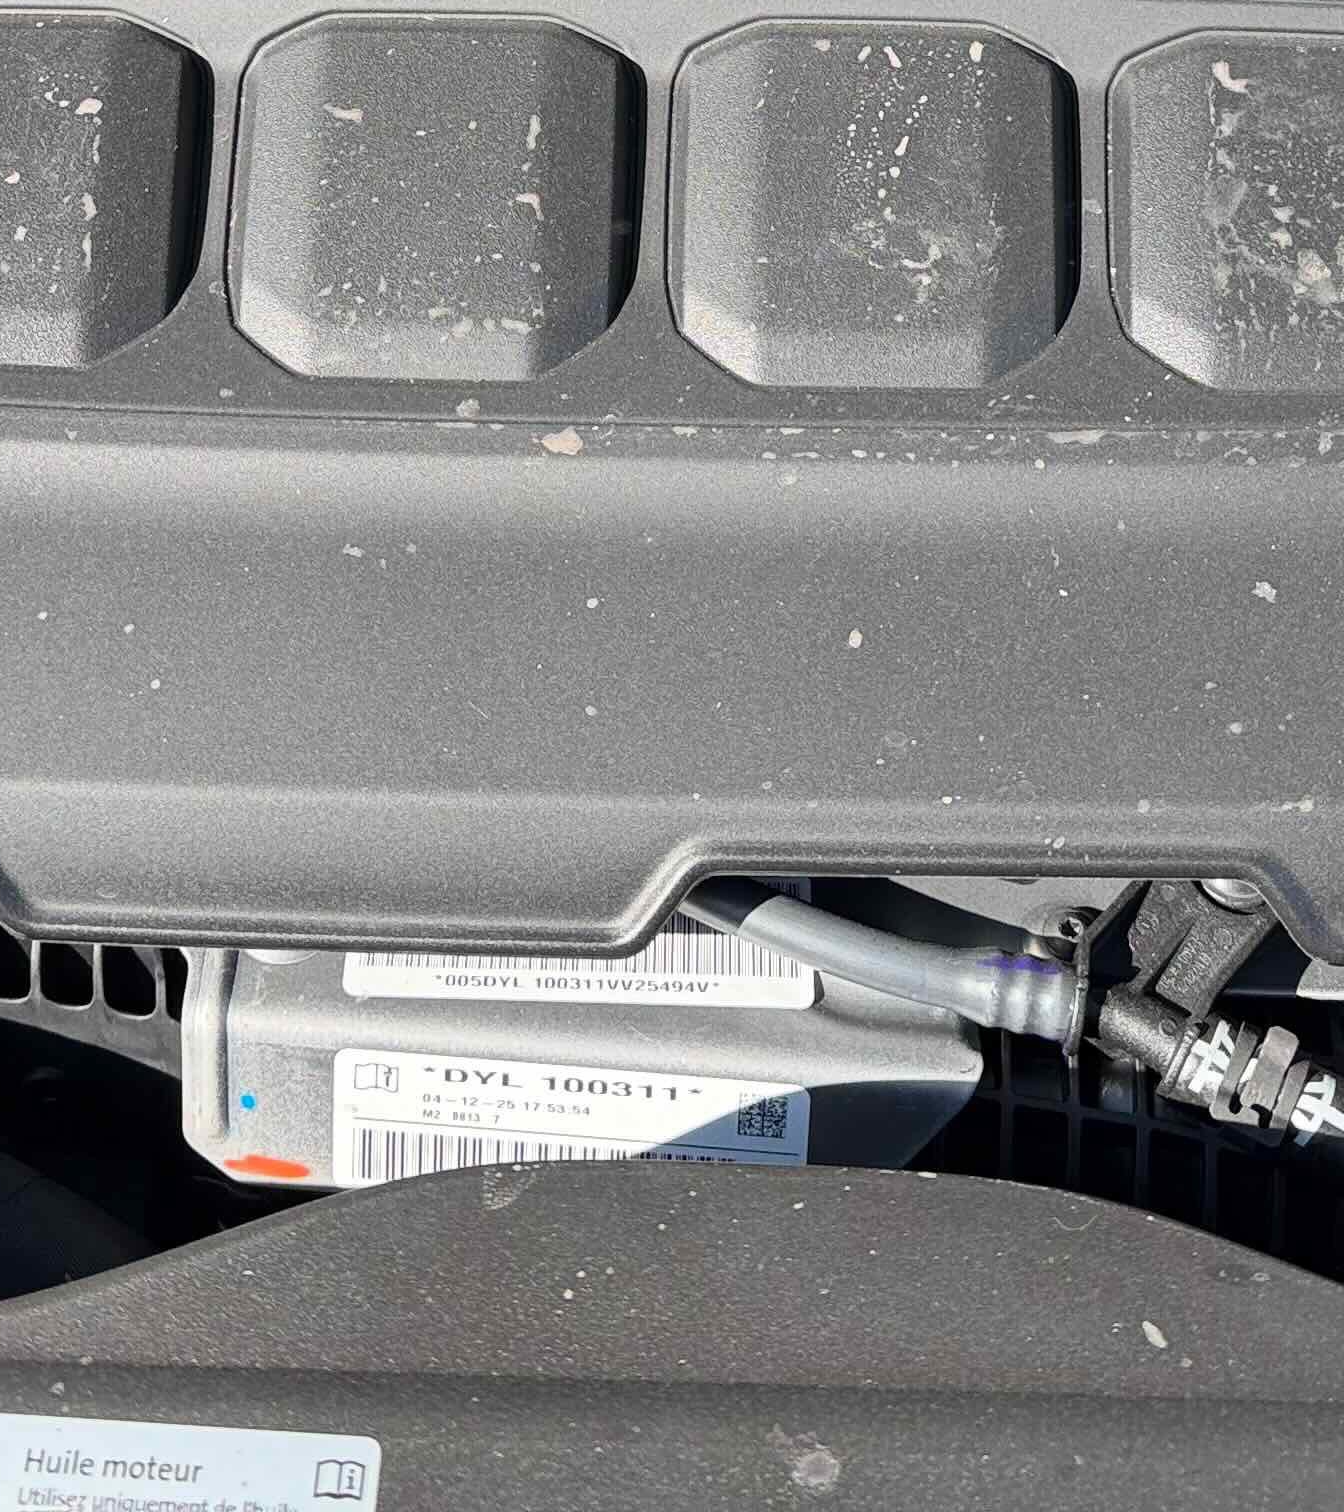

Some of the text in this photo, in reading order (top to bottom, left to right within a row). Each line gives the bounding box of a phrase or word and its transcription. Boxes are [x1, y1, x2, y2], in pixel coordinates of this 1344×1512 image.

[23, 1448, 203, 1483] Huile moteur
[18, 1486, 86, 1509] Utilisez
